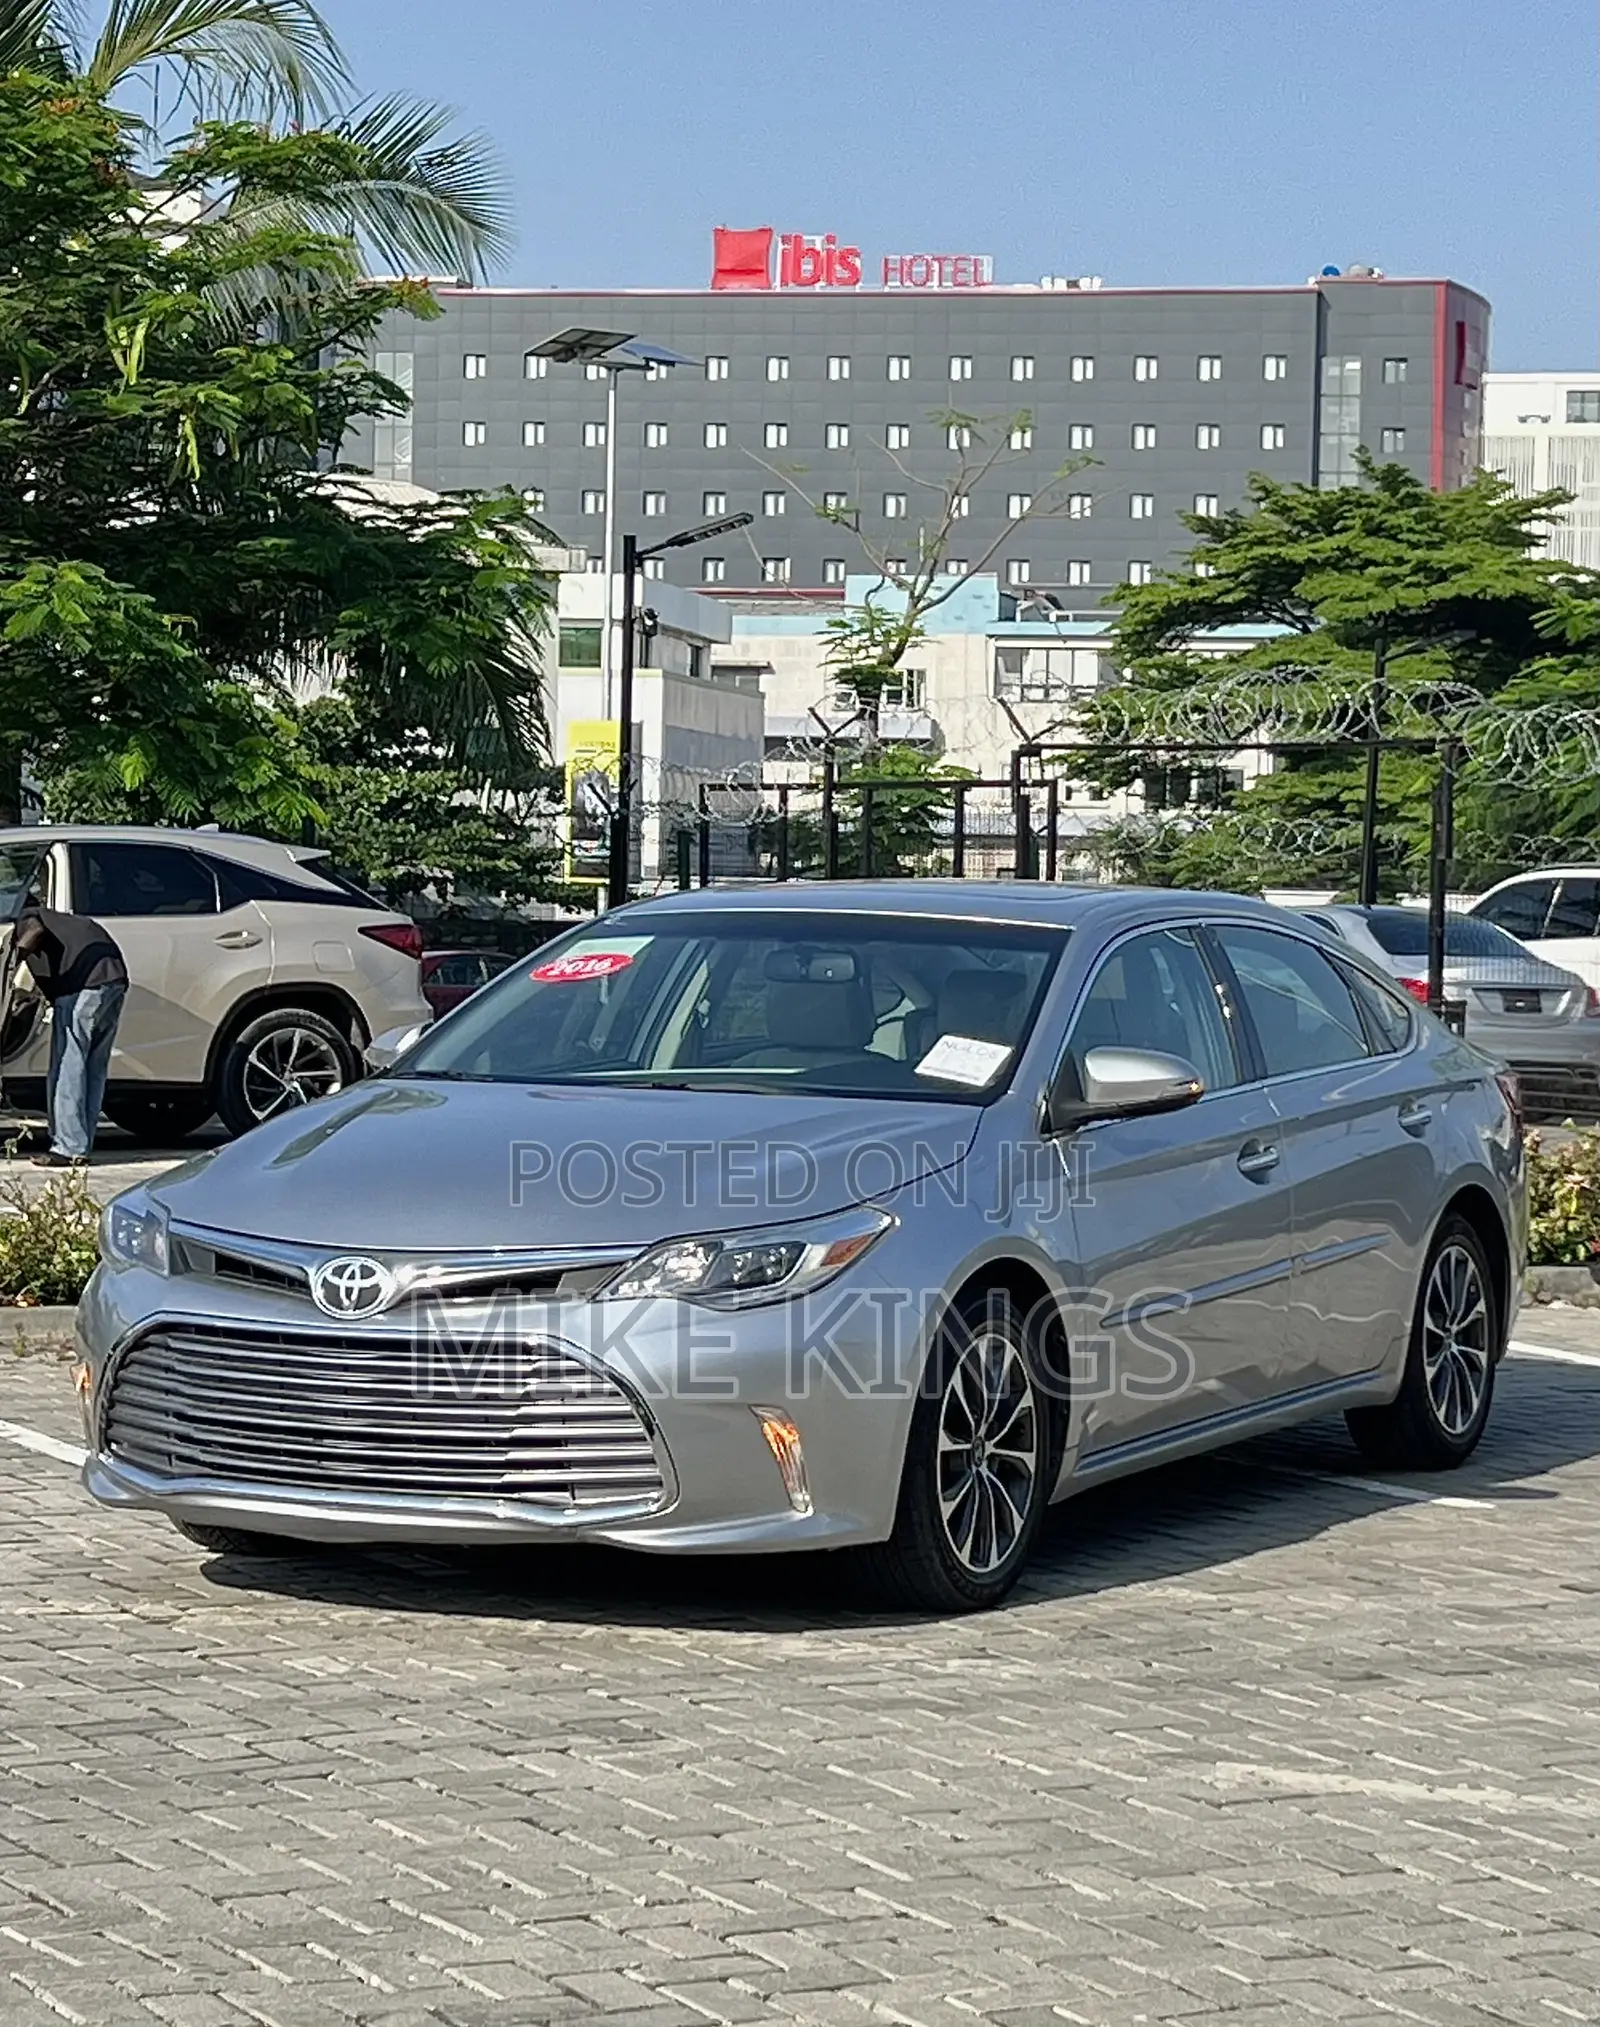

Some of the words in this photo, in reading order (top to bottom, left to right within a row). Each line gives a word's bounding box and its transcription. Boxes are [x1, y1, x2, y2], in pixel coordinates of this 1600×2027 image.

[780, 233, 862, 287] ibis
[882, 253, 994, 287] HOTEL
[546, 957, 614, 976] 2016
